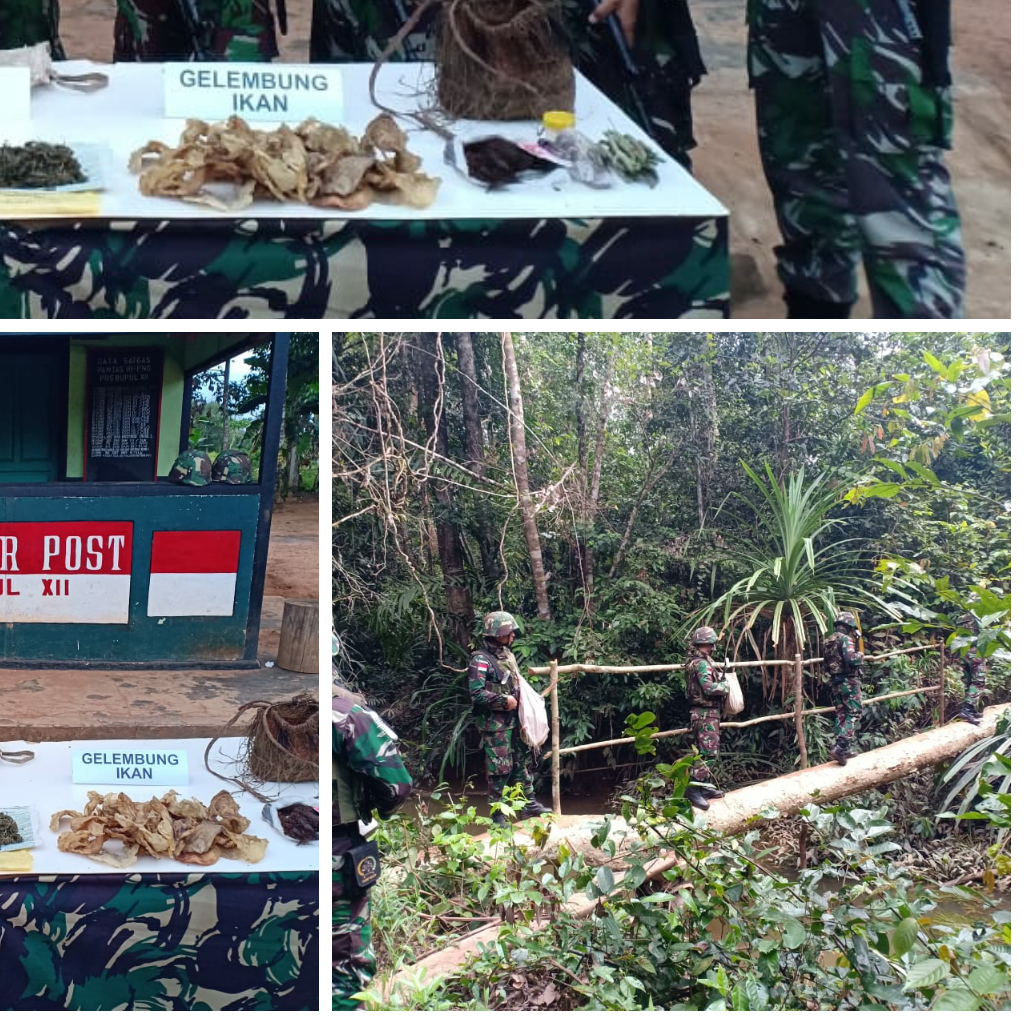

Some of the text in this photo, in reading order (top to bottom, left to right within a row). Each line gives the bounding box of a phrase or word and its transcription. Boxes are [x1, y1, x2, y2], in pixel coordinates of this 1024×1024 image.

[179, 69, 329, 92] GELEMBUNG
[232, 92, 289, 113] IKAN
[42, 534, 125, 571] POST
[42, 578, 70, 596] XII
[81, 752, 179, 766] GELEMBUNG
[116, 767, 153, 779] IKAN
